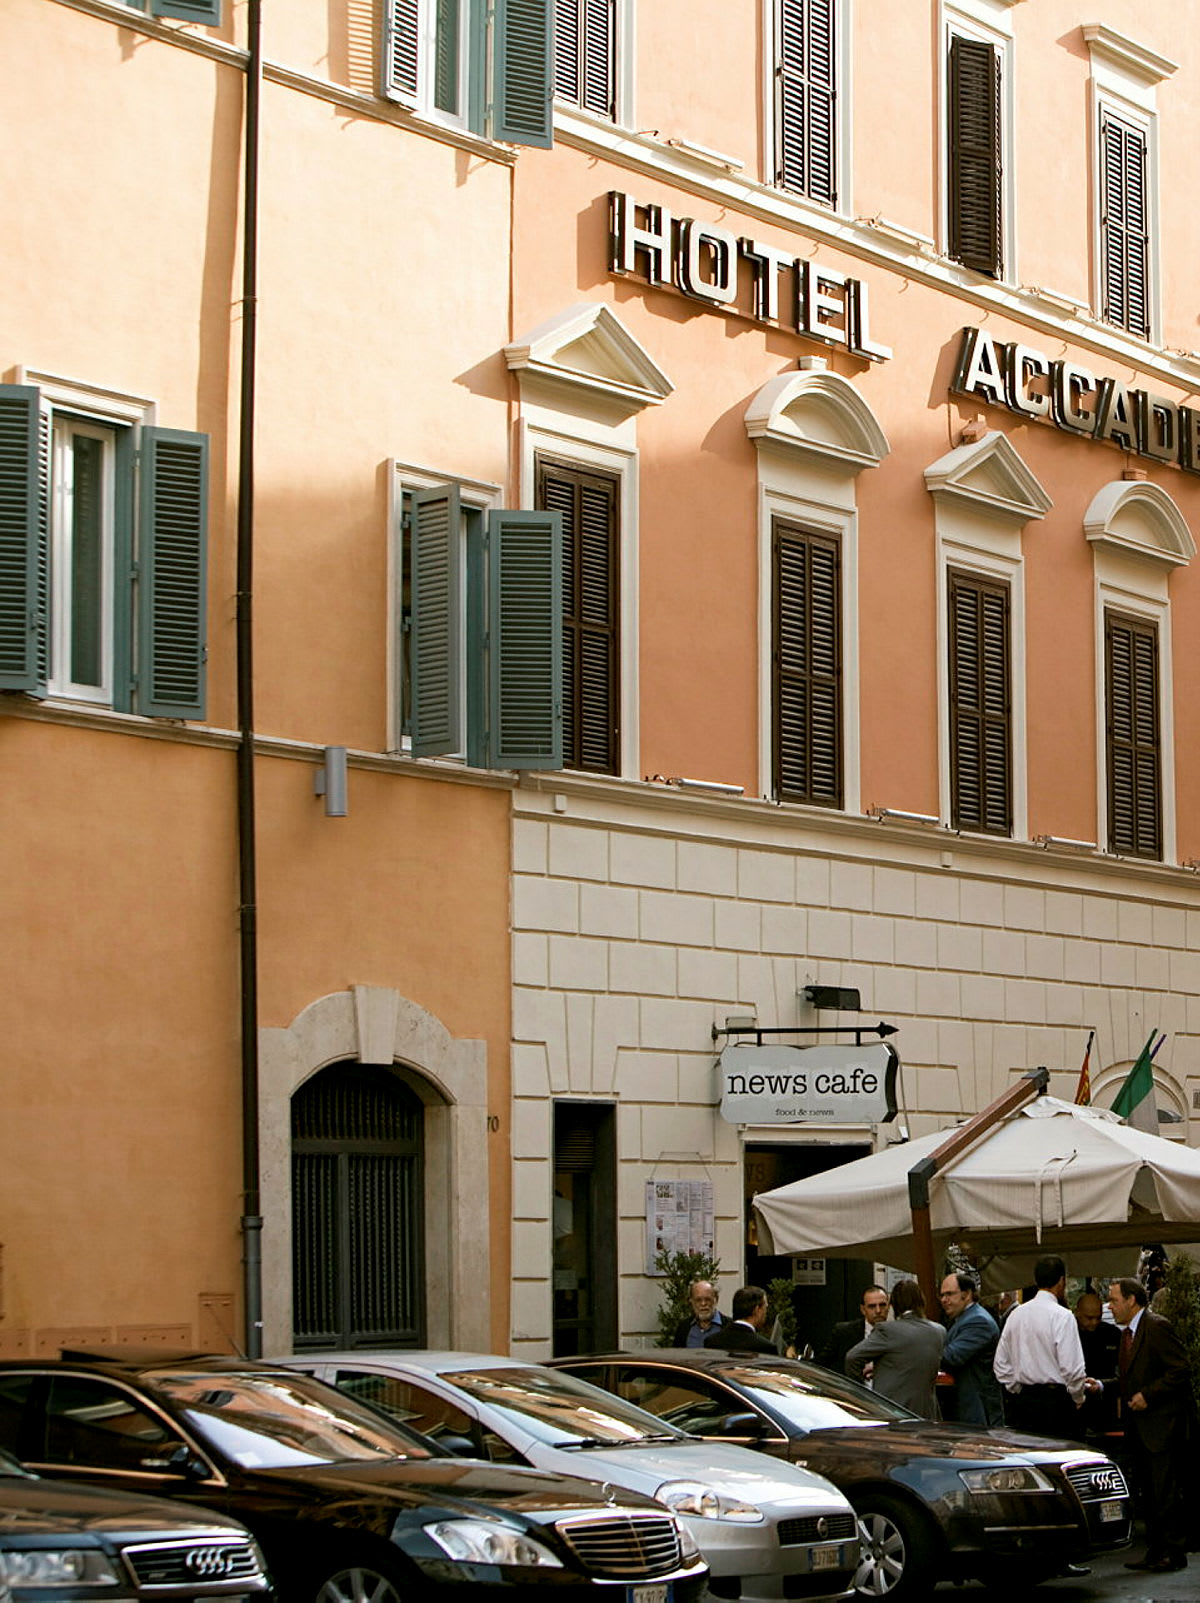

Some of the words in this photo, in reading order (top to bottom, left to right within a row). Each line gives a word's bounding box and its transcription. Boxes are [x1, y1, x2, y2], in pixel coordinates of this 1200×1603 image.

[608, 190, 893, 364] HOTEL
[727, 1073, 808, 1095] news
[815, 1068, 878, 1094] cafe
[775, 1108, 796, 1116] food
